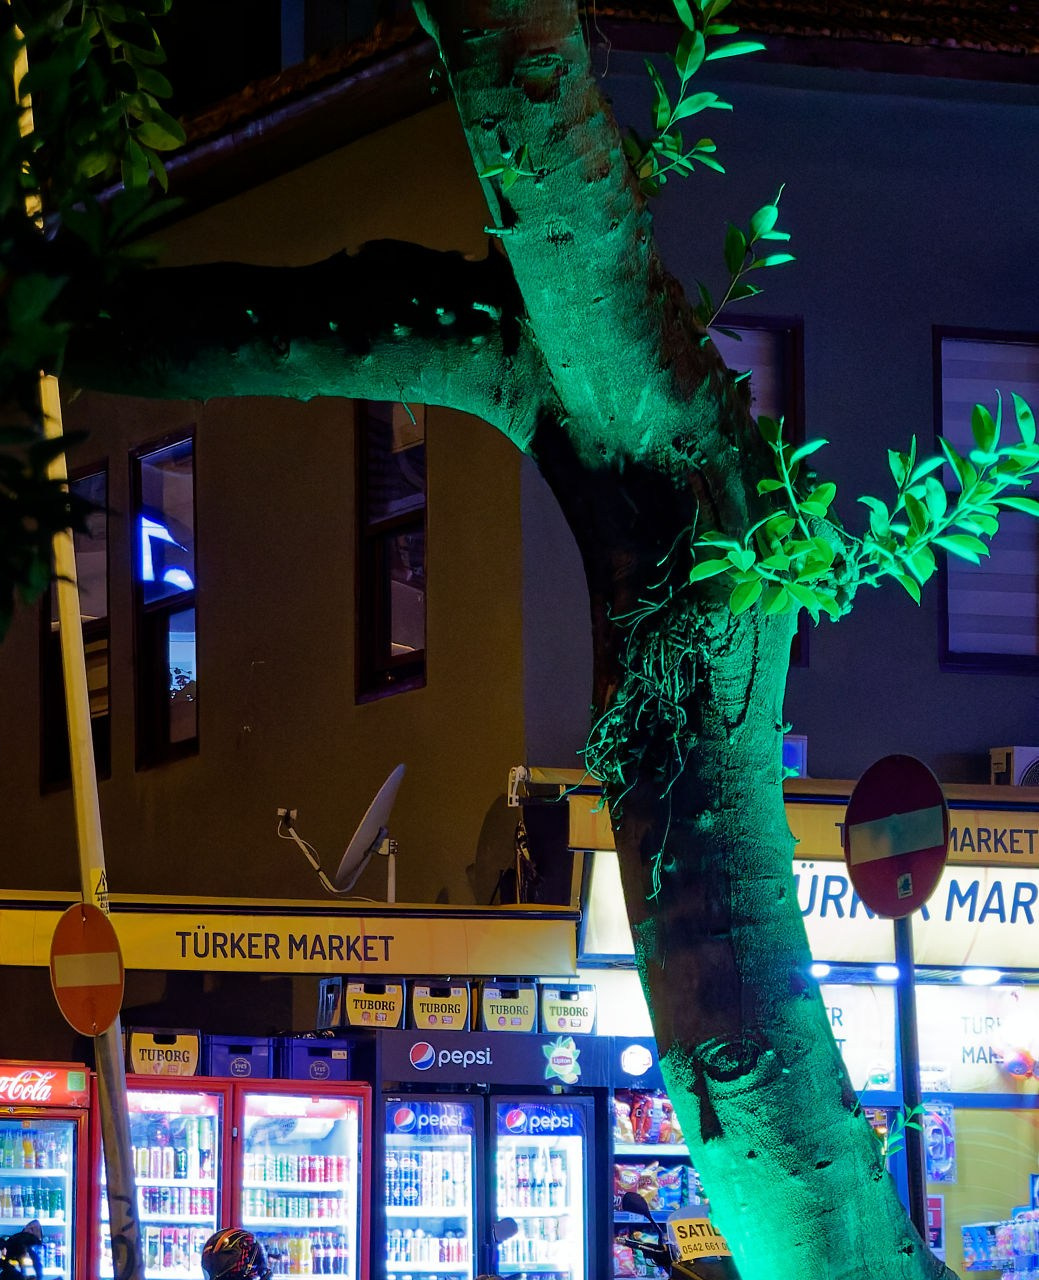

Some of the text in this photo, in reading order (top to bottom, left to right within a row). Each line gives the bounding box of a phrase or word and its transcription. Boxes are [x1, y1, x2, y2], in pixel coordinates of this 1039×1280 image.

[175, 925, 395, 962] TÜRKER MARKET
[353, 998, 396, 1012] TUBORG
[420, 1002, 461, 1015] TUBORG
[489, 1004, 529, 1016] TUBORG
[549, 1005, 589, 1017] TUBORG
[139, 1048, 190, 1063] TUBORG
[438, 1048, 492, 1068] pepsi
[418, 1112, 463, 1130] pepsi
[529, 1113, 574, 1131] pepsi
[683, 1242, 704, 1255] 0542
